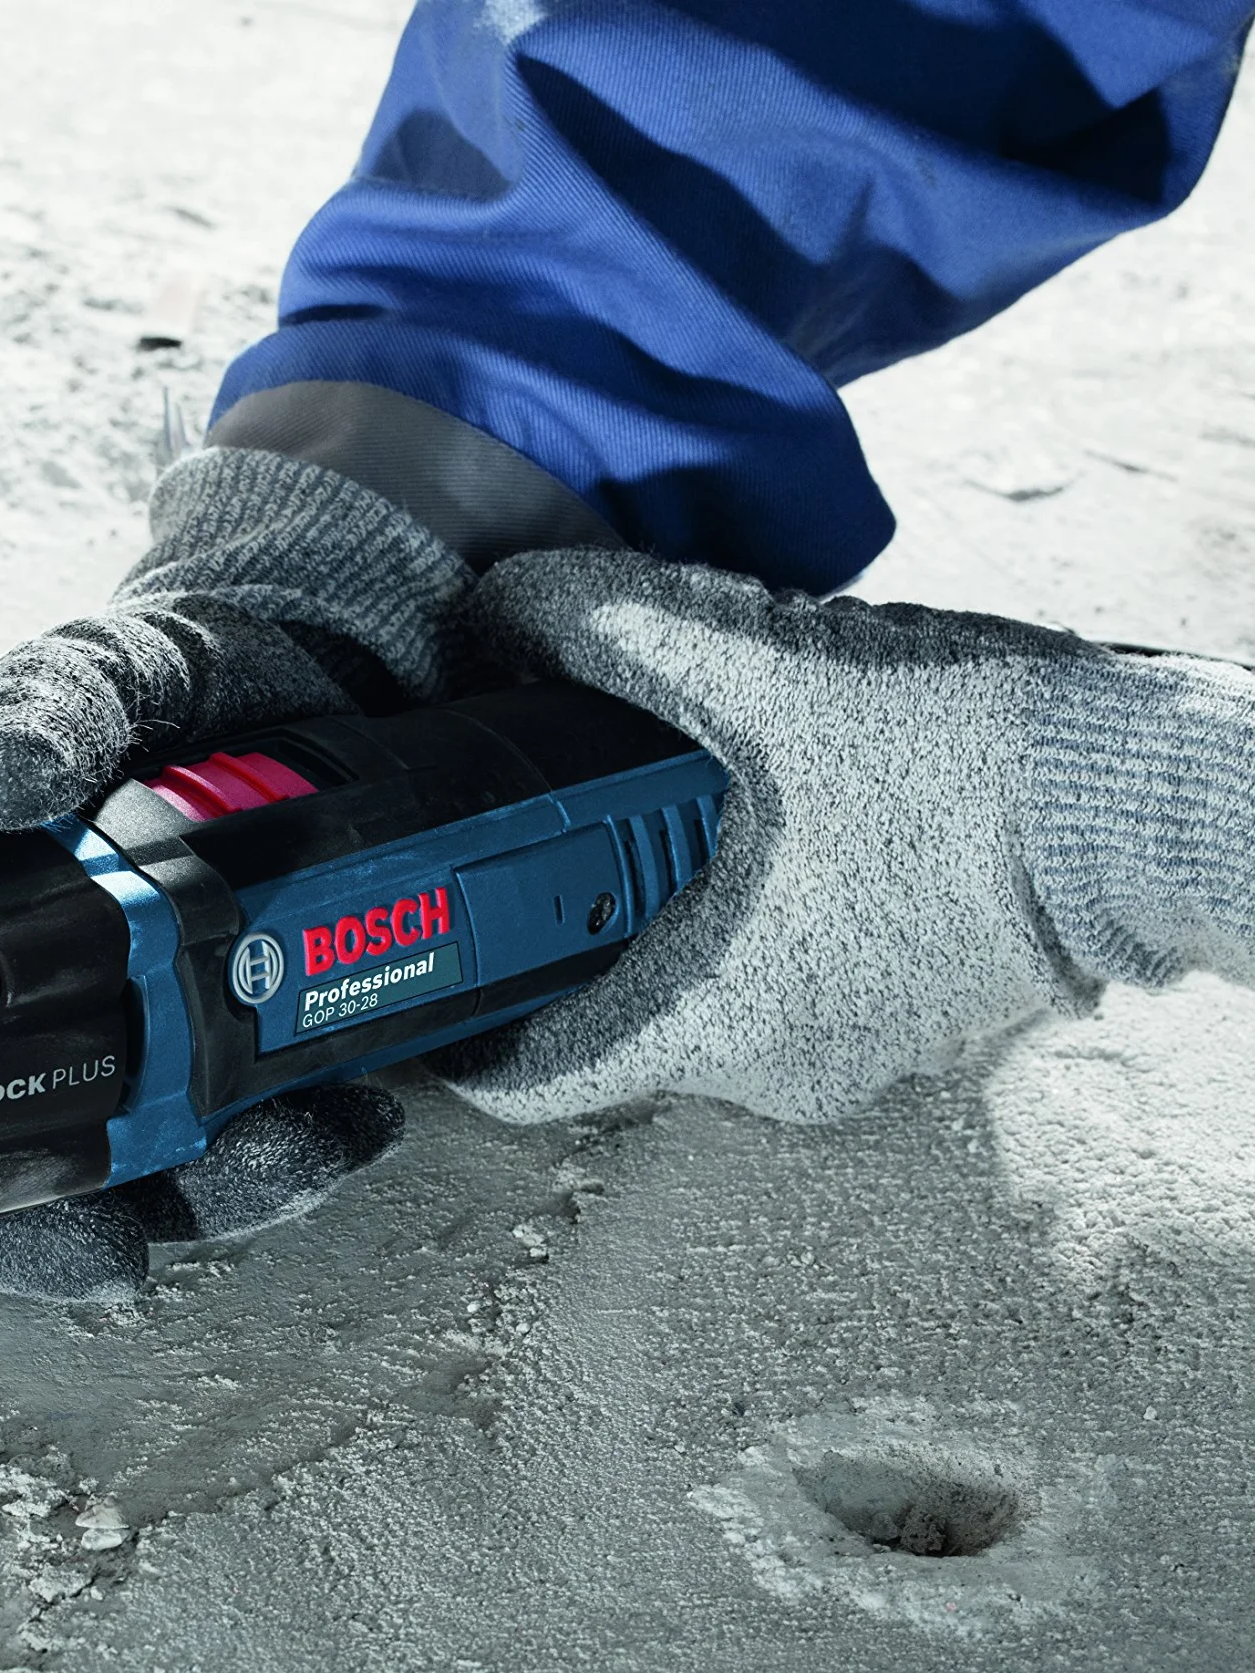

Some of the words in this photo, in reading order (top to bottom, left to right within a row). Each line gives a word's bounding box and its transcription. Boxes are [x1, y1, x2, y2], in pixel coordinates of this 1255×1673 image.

[302, 886, 451, 977] BOSCH
[303, 951, 436, 1012] Professional
[302, 1005, 336, 1029] GOP
[337, 993, 379, 1018] 30-28
[52, 1055, 116, 1090] PLUS
